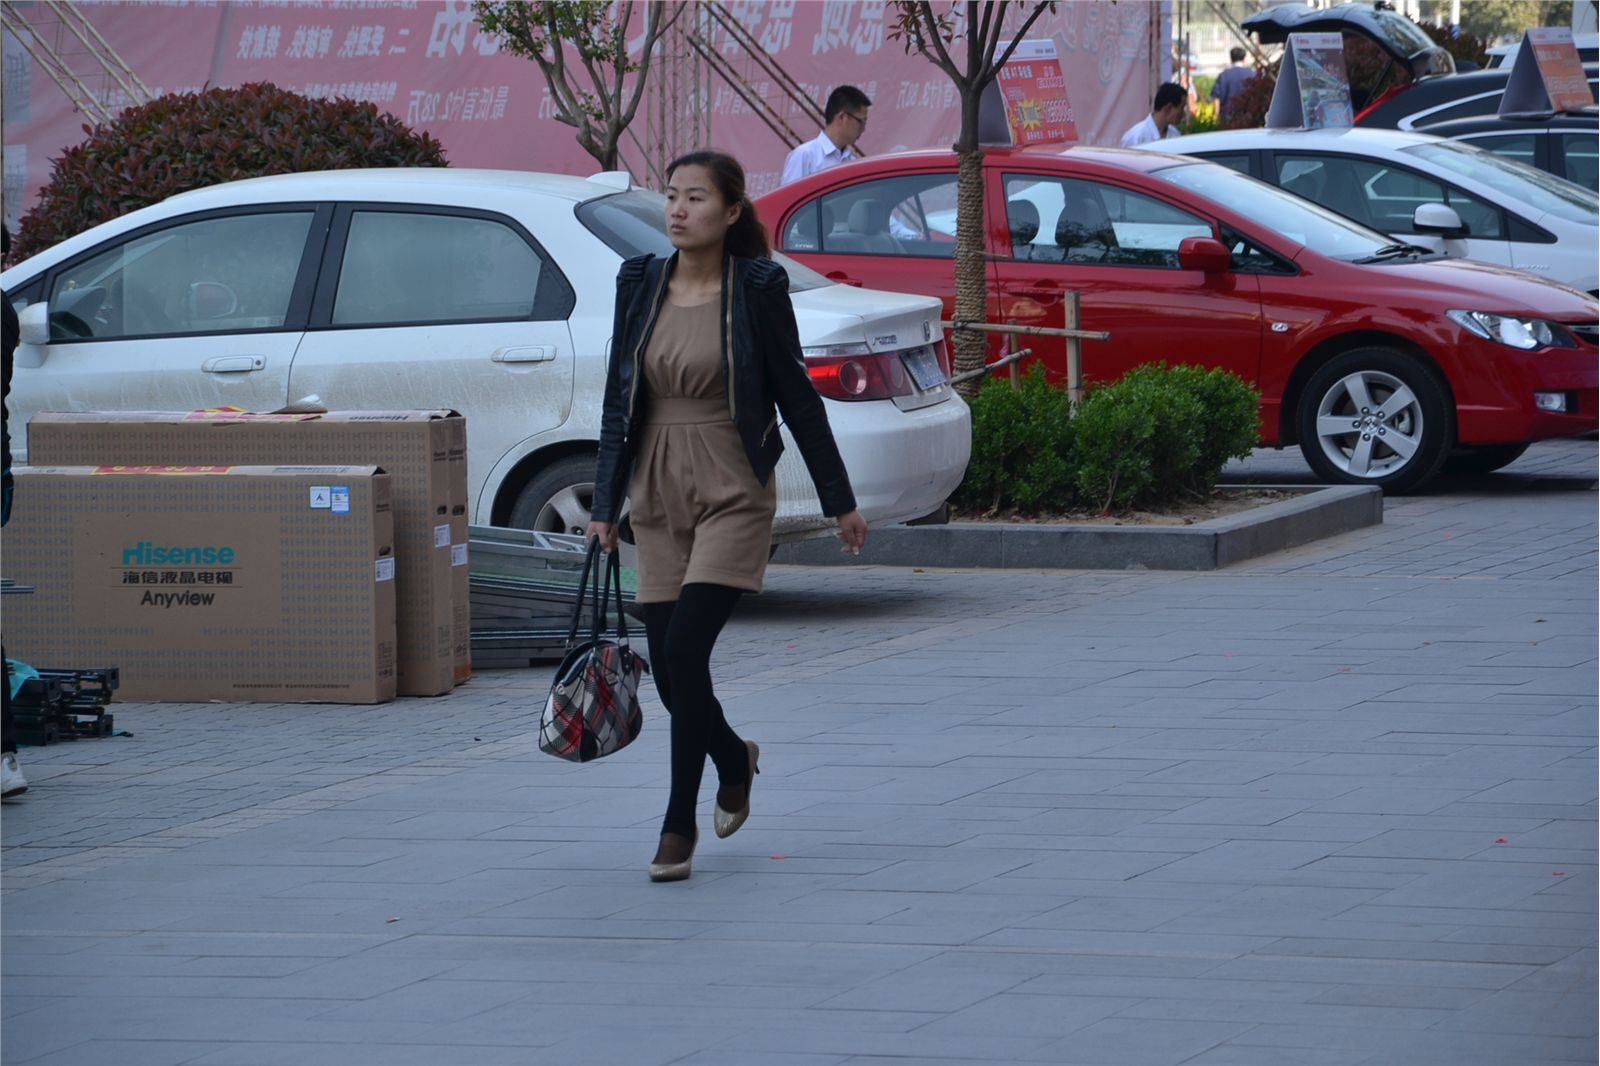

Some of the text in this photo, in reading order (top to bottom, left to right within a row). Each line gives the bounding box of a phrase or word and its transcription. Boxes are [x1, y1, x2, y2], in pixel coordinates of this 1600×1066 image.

[122, 541, 235, 565] Hisense
[122, 570, 233, 585] 海信液晶电视
[140, 589, 215, 609] Anyview
